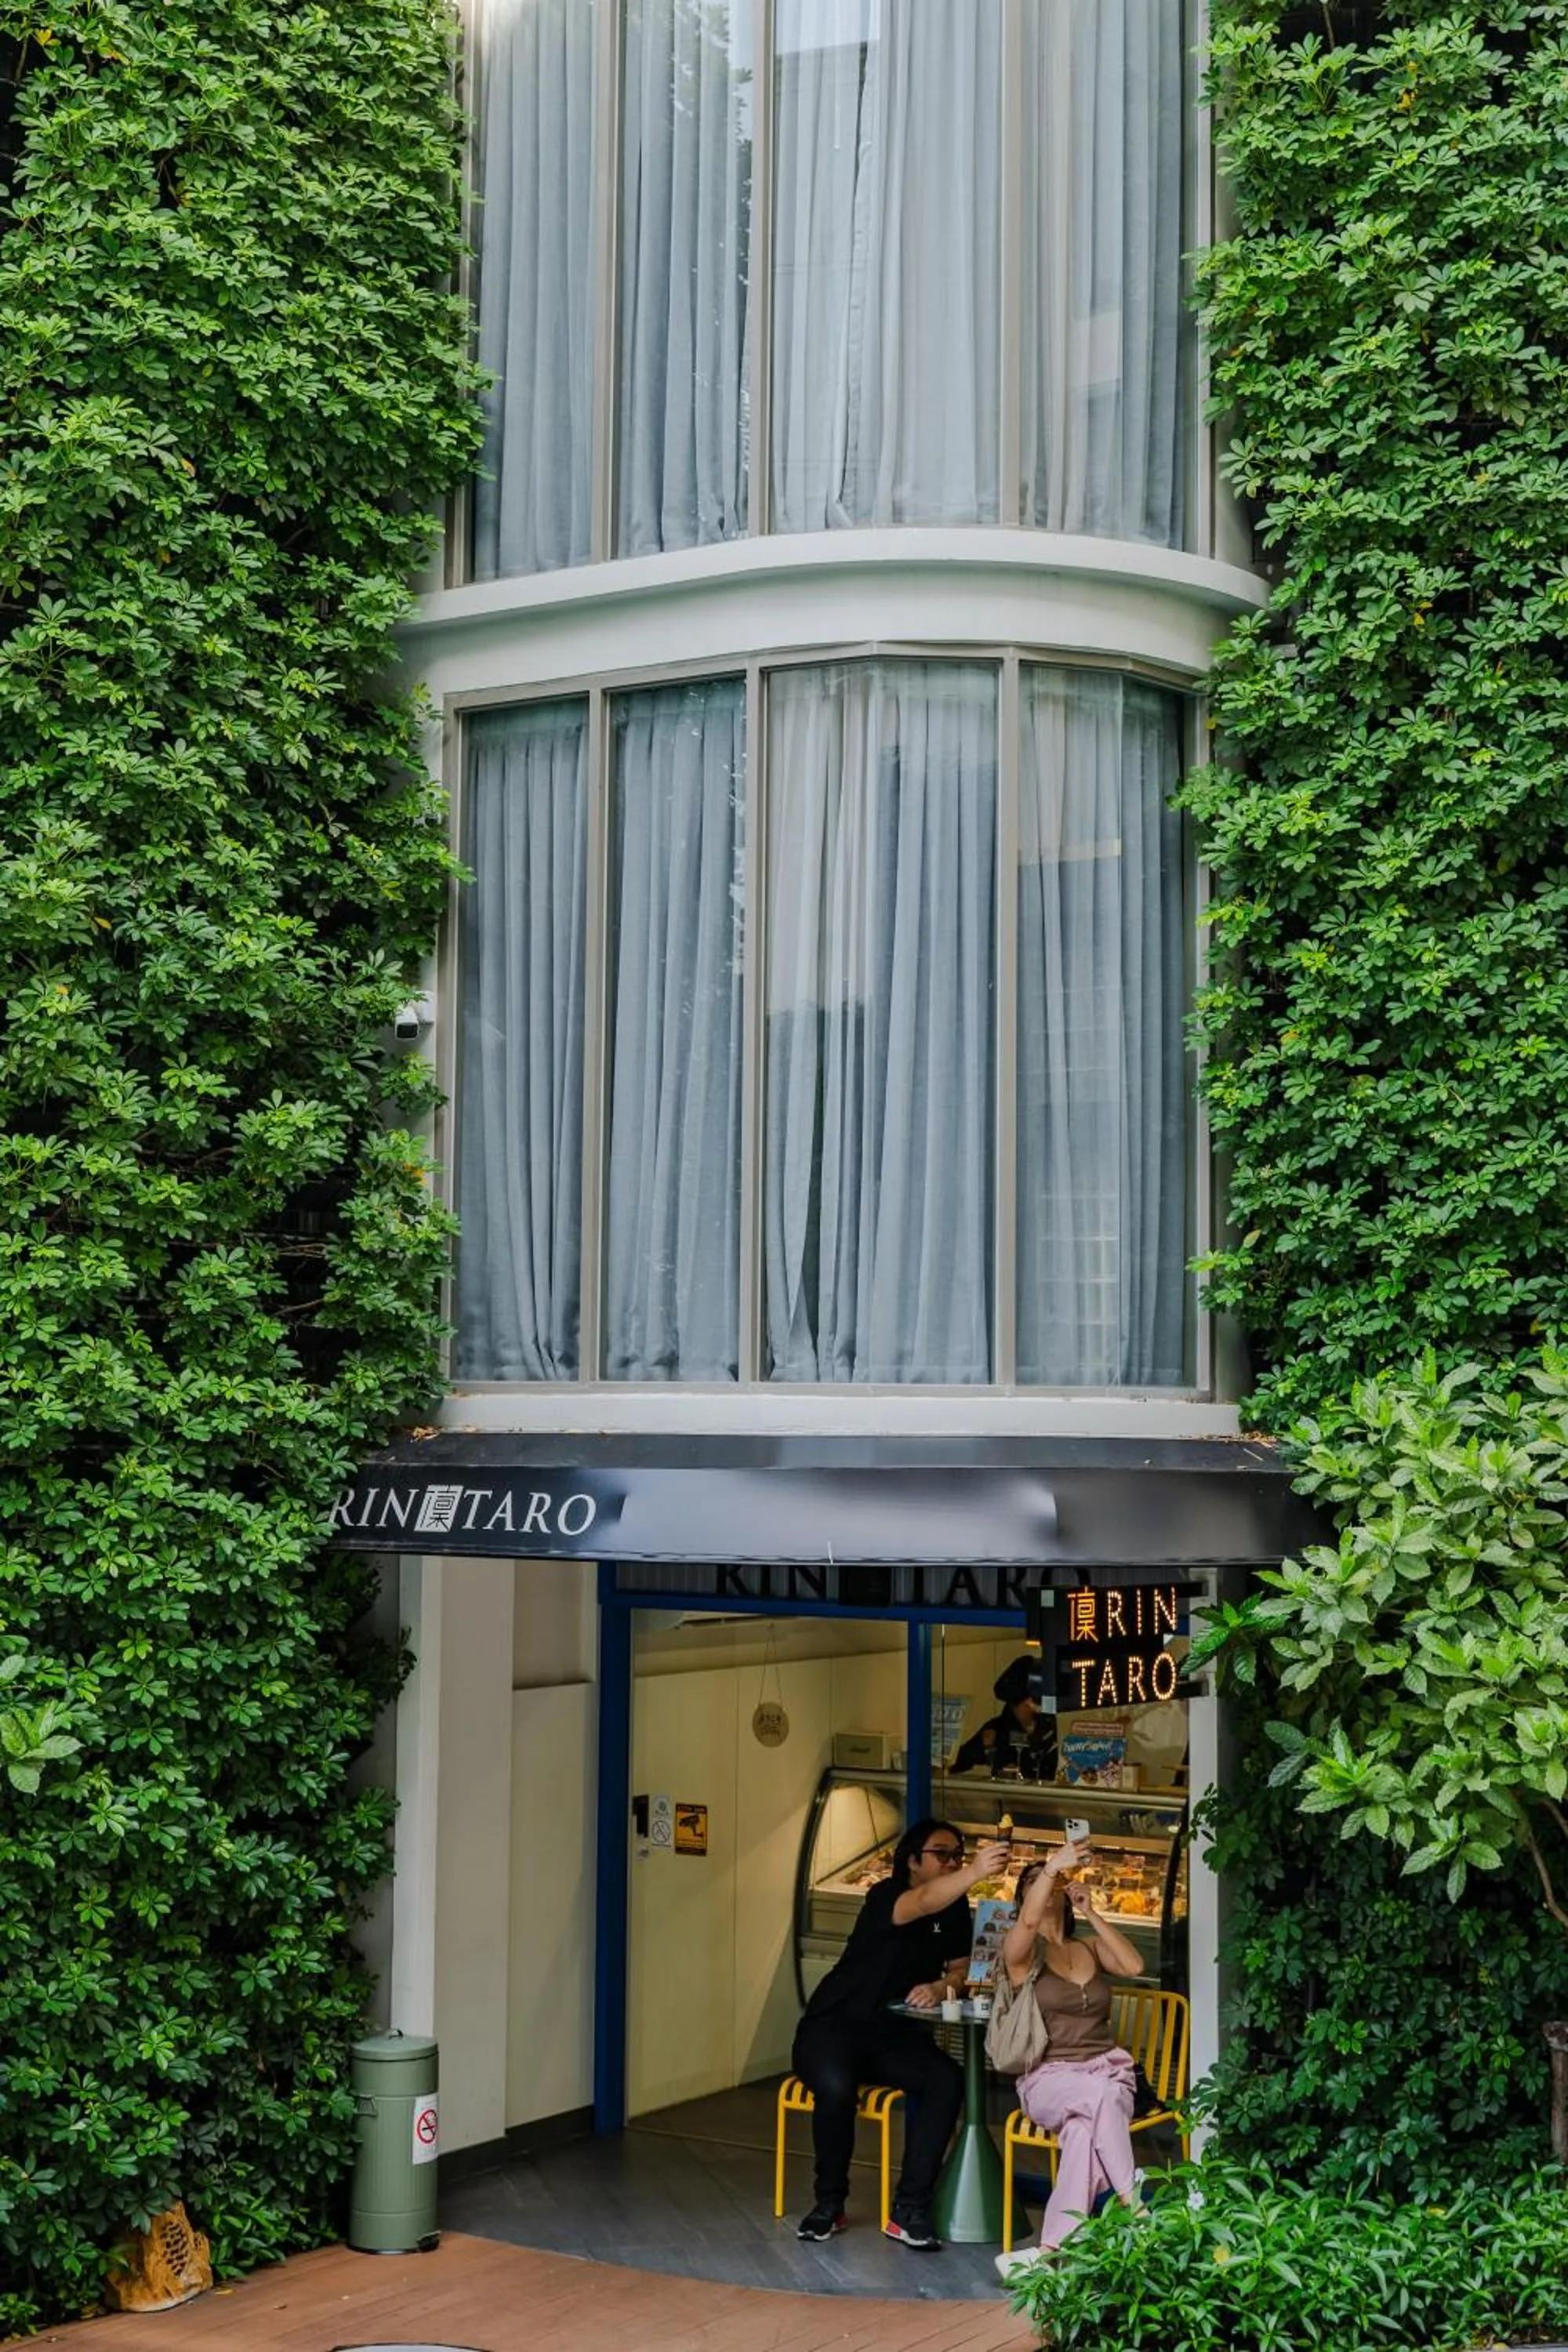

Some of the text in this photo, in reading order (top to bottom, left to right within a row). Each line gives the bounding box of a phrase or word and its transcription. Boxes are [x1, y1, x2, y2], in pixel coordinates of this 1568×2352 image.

[329, 1487, 419, 1528] RIN
[463, 1490, 597, 1536] TARO
[1107, 1586, 1177, 1638] RIN
[1071, 1652, 1177, 1708] TARO
